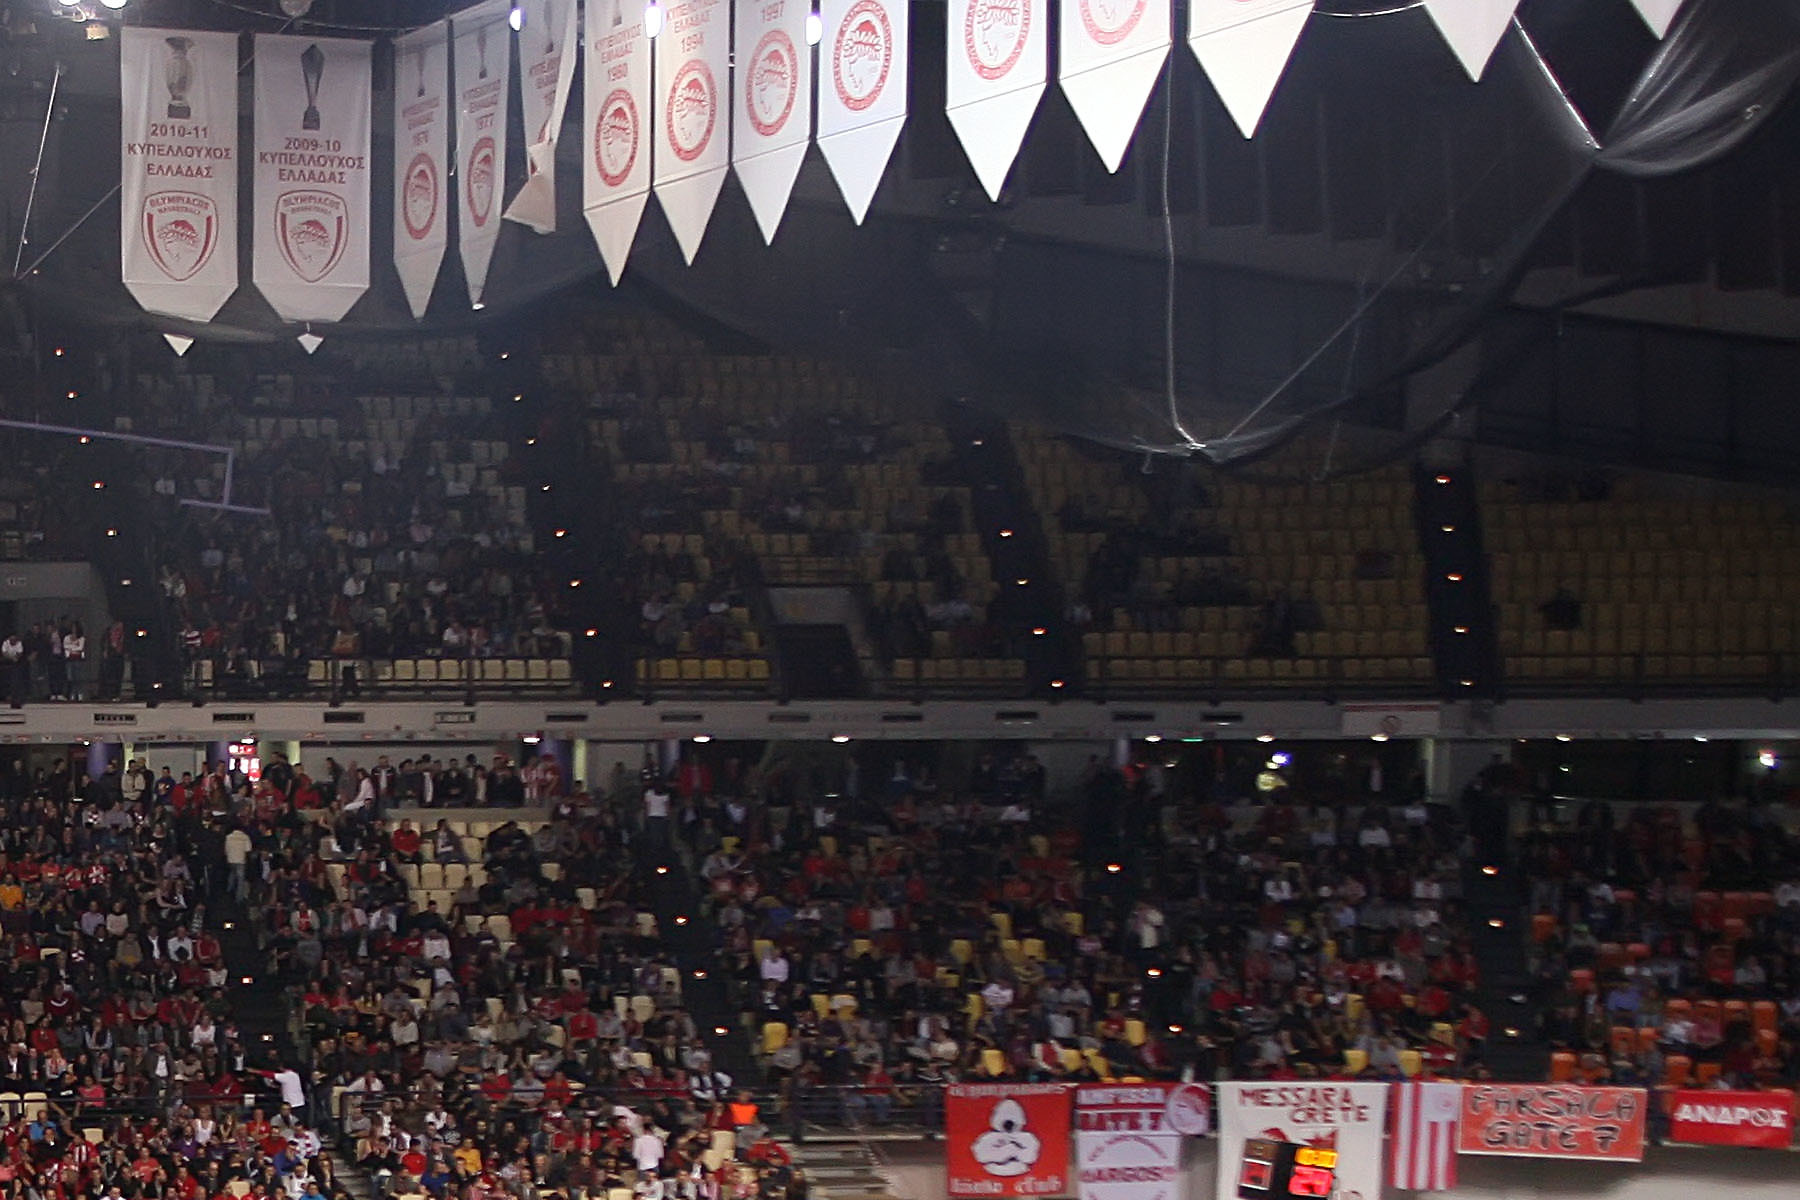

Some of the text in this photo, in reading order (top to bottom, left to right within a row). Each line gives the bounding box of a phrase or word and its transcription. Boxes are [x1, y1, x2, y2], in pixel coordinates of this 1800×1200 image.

[150, 123, 209, 138] 2010-11
[127, 143, 232, 160] ΚΥΠΕΛΛΟΥΧΟΣ
[284, 137, 342, 152] 2009-10
[259, 152, 366, 170] ΚΥΠΕΛΛΟΥΧΟΣ
[146, 164, 213, 179] ΕΛΛΑΔΑΣ
[278, 168, 347, 185] ΕΛΛΑΔΑΣ
[1238, 1088, 1354, 1108] MESSARA
[1290, 1105, 1370, 1123] CRETE
[1674, 1103, 1788, 1128] ΑΝΔΡΟΣ
[1484, 1121, 1621, 1152] GATE 7
